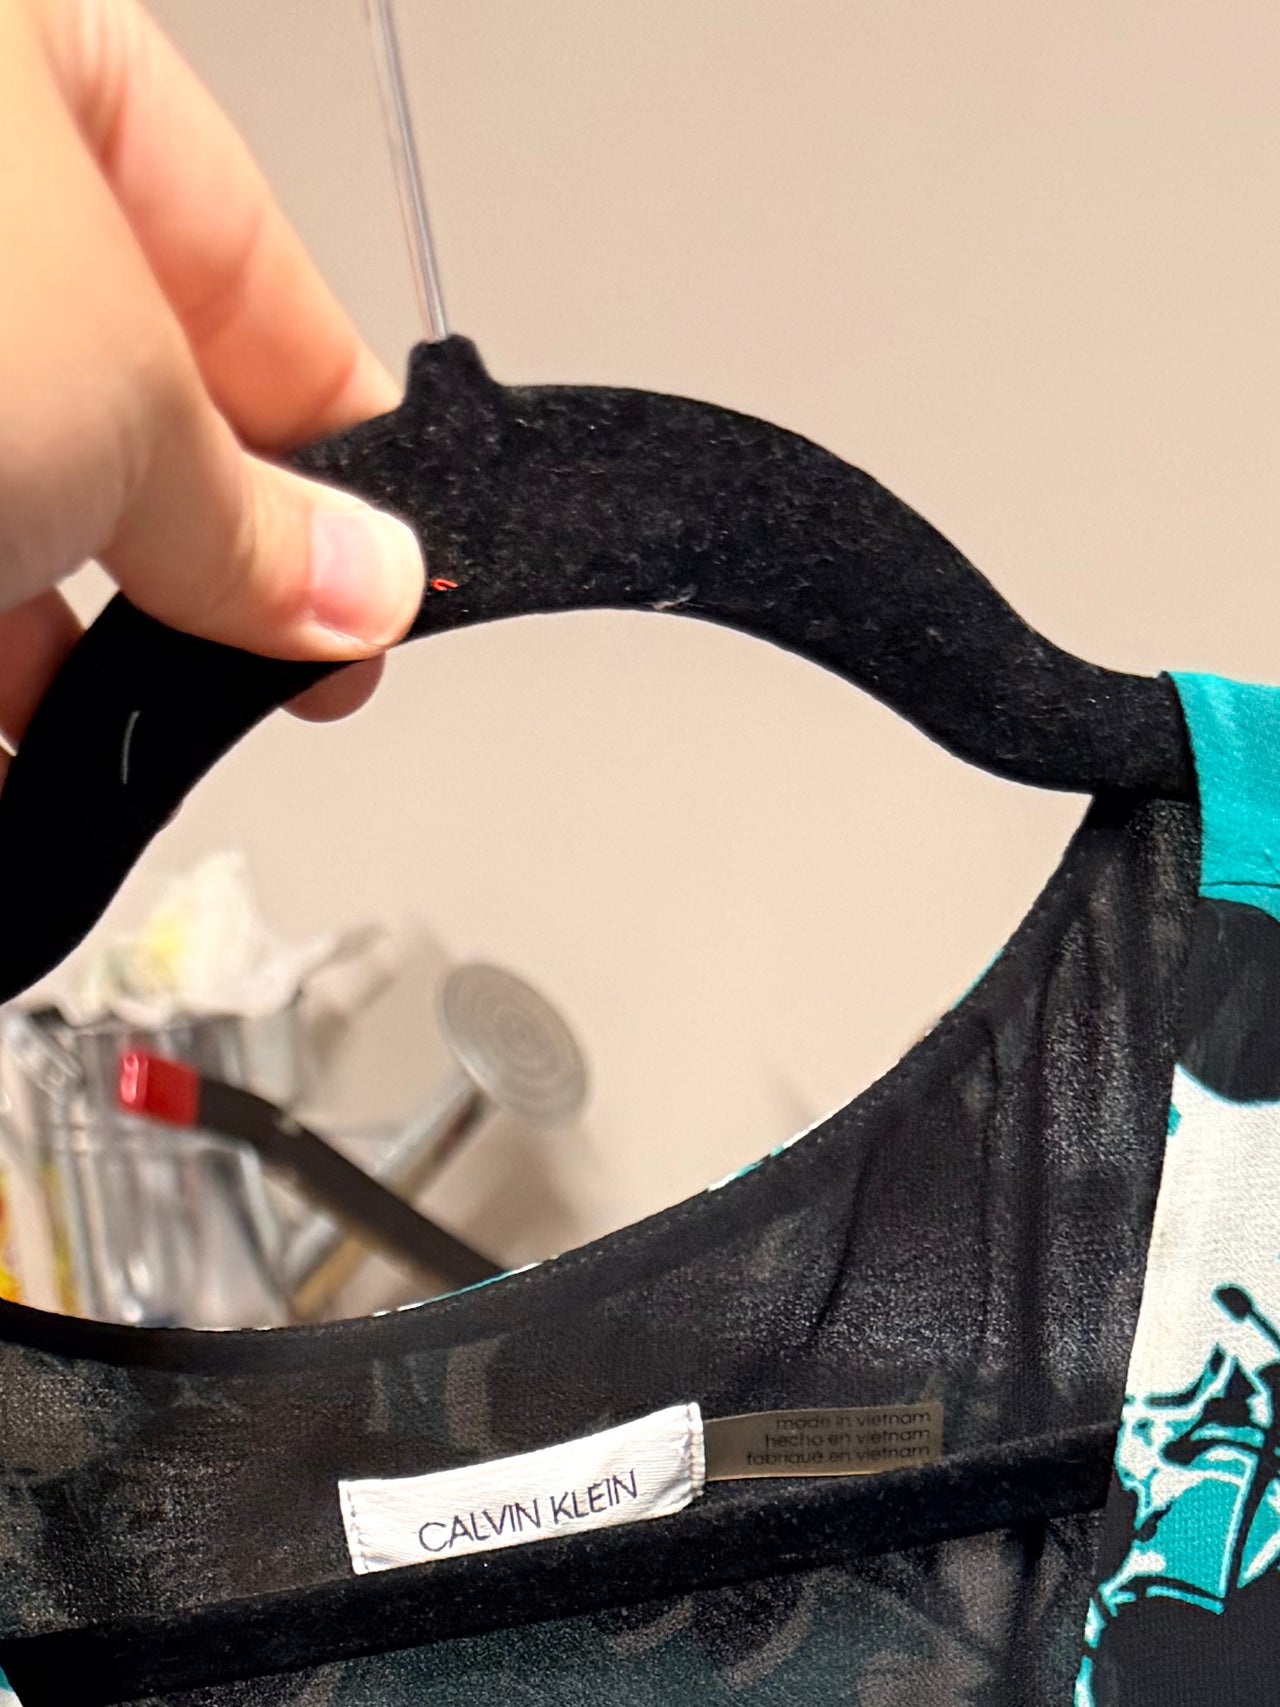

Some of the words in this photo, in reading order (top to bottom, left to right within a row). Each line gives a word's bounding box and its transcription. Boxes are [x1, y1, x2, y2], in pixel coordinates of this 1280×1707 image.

[776, 1415, 830, 1431] made
[836, 1414, 852, 1428] in
[856, 1410, 932, 1427] vietnam
[765, 1431, 823, 1448] hecho
[828, 1431, 852, 1445] en
[856, 1427, 930, 1444] vietnam
[829, 1450, 852, 1463] en
[855, 1444, 930, 1462] vietnam
[418, 1498, 542, 1552] CALVIN
[549, 1468, 638, 1525] KLEIN
